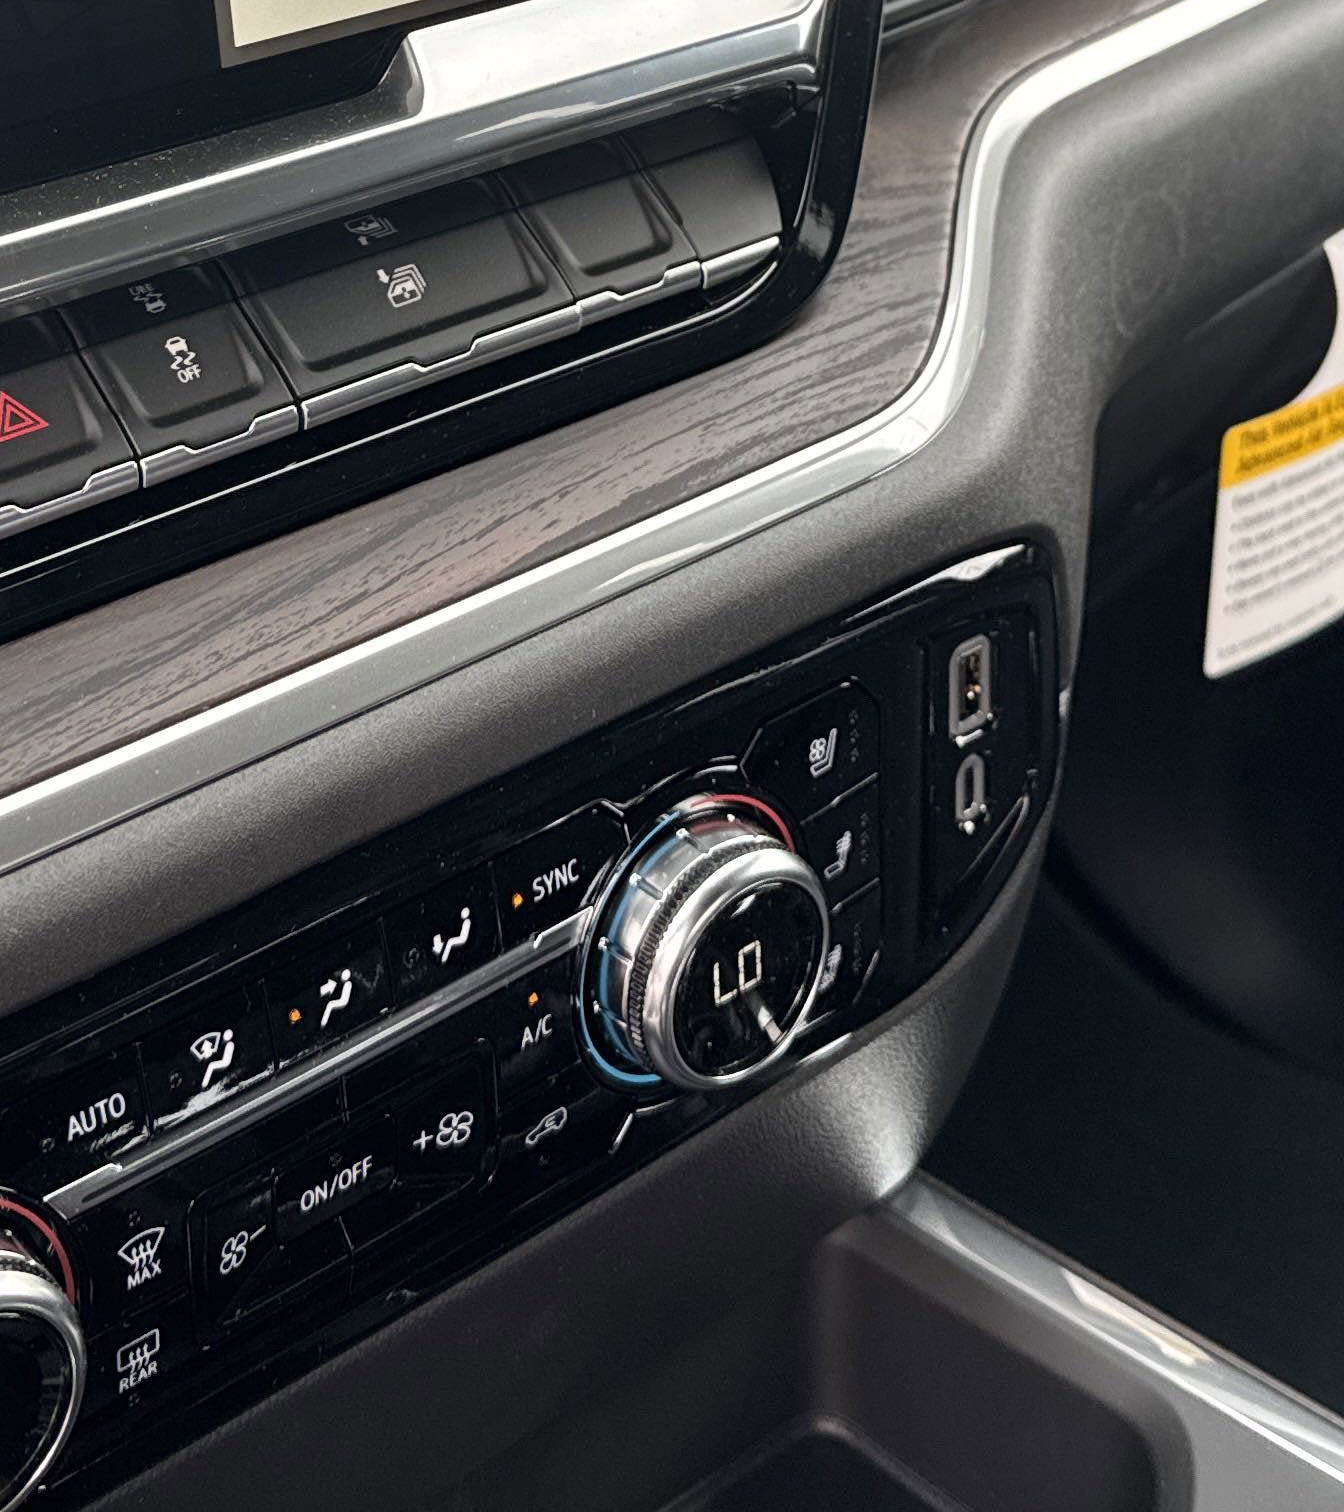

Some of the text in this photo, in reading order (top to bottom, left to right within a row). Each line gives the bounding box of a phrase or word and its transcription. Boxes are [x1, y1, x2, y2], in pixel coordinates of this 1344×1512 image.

[177, 364, 201, 384] OFF
[531, 857, 581, 903] SYNC
[521, 1013, 553, 1050] A/C
[66, 1092, 126, 1143] AUTO
[299, 1154, 374, 1213] ON/OFF
[126, 1261, 163, 1290] MAX
[118, 1362, 158, 1393] REAR
